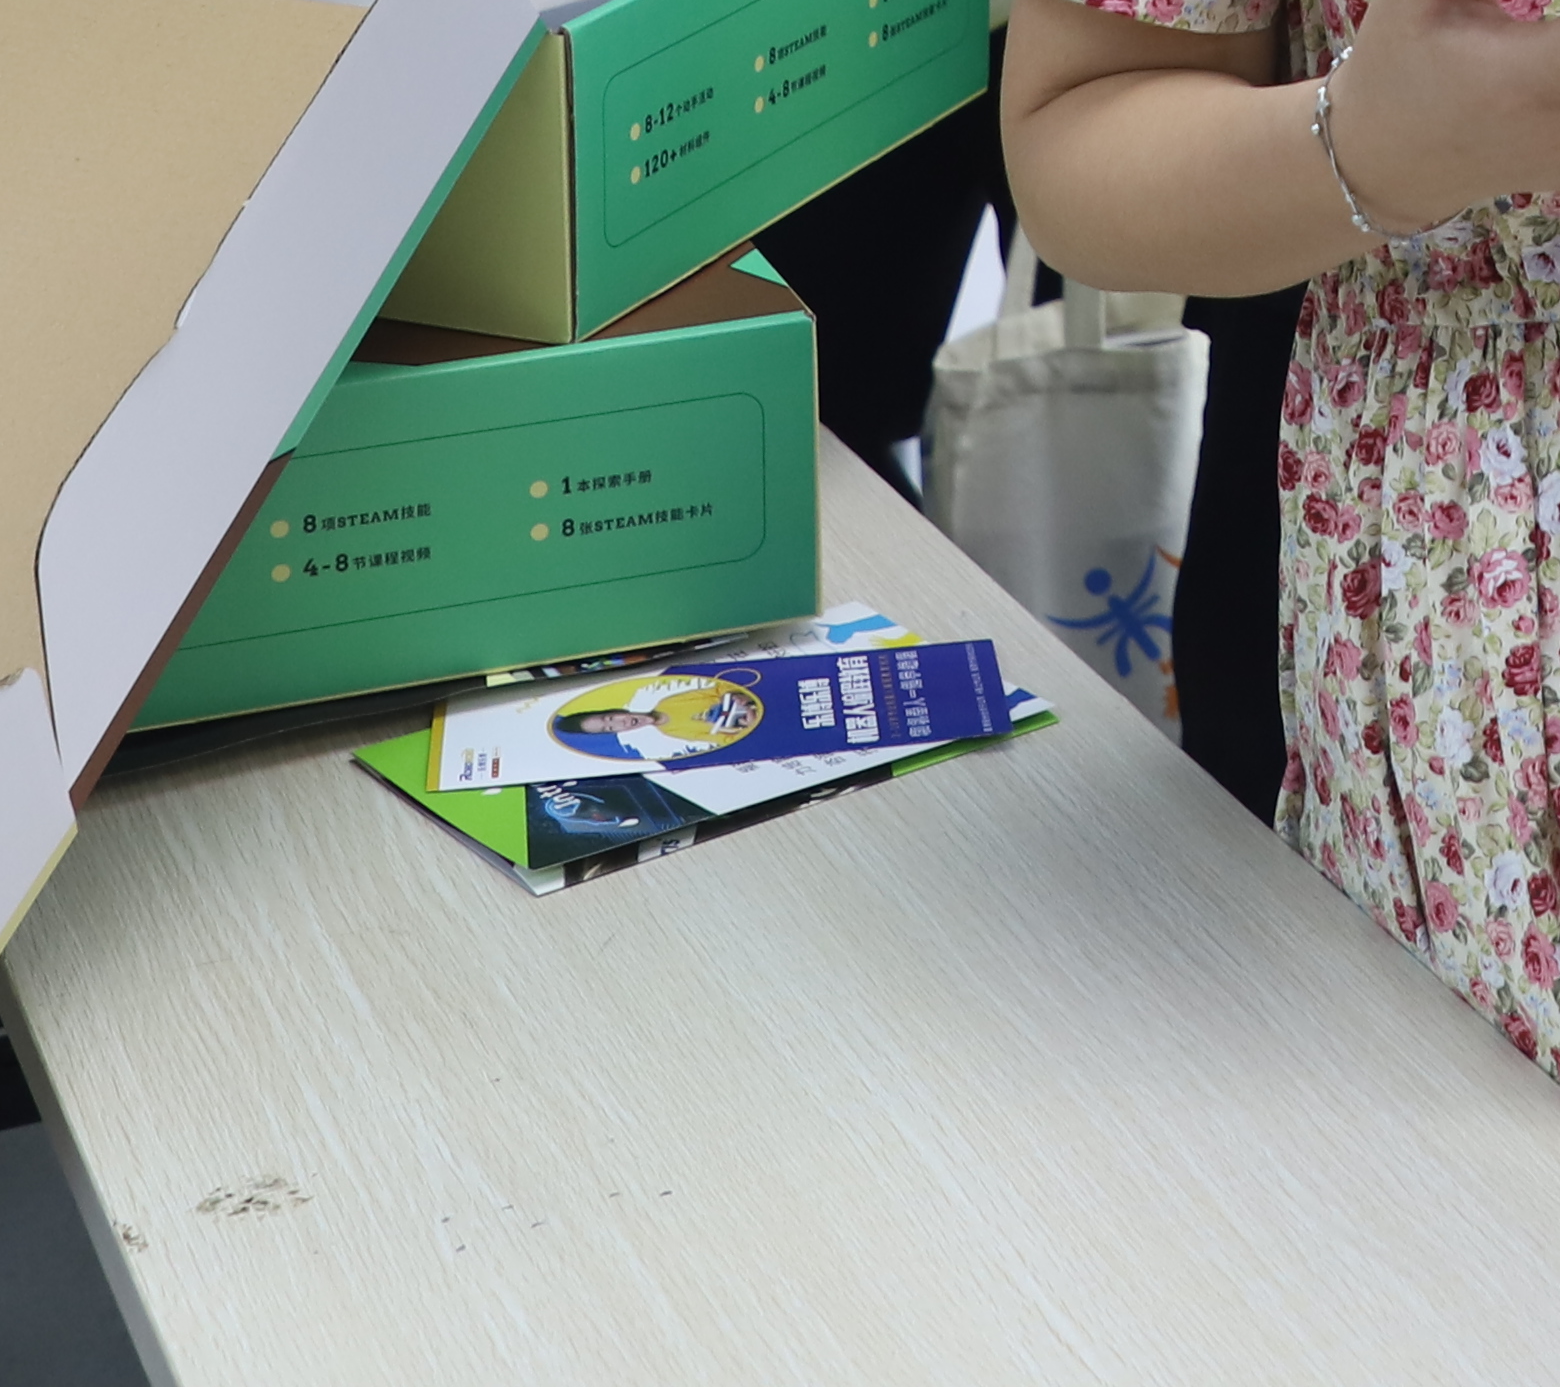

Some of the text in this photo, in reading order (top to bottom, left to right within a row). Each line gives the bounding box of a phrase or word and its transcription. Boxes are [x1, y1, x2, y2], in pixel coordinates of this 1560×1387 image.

[836, 654, 880, 745] 机器人编程教育
